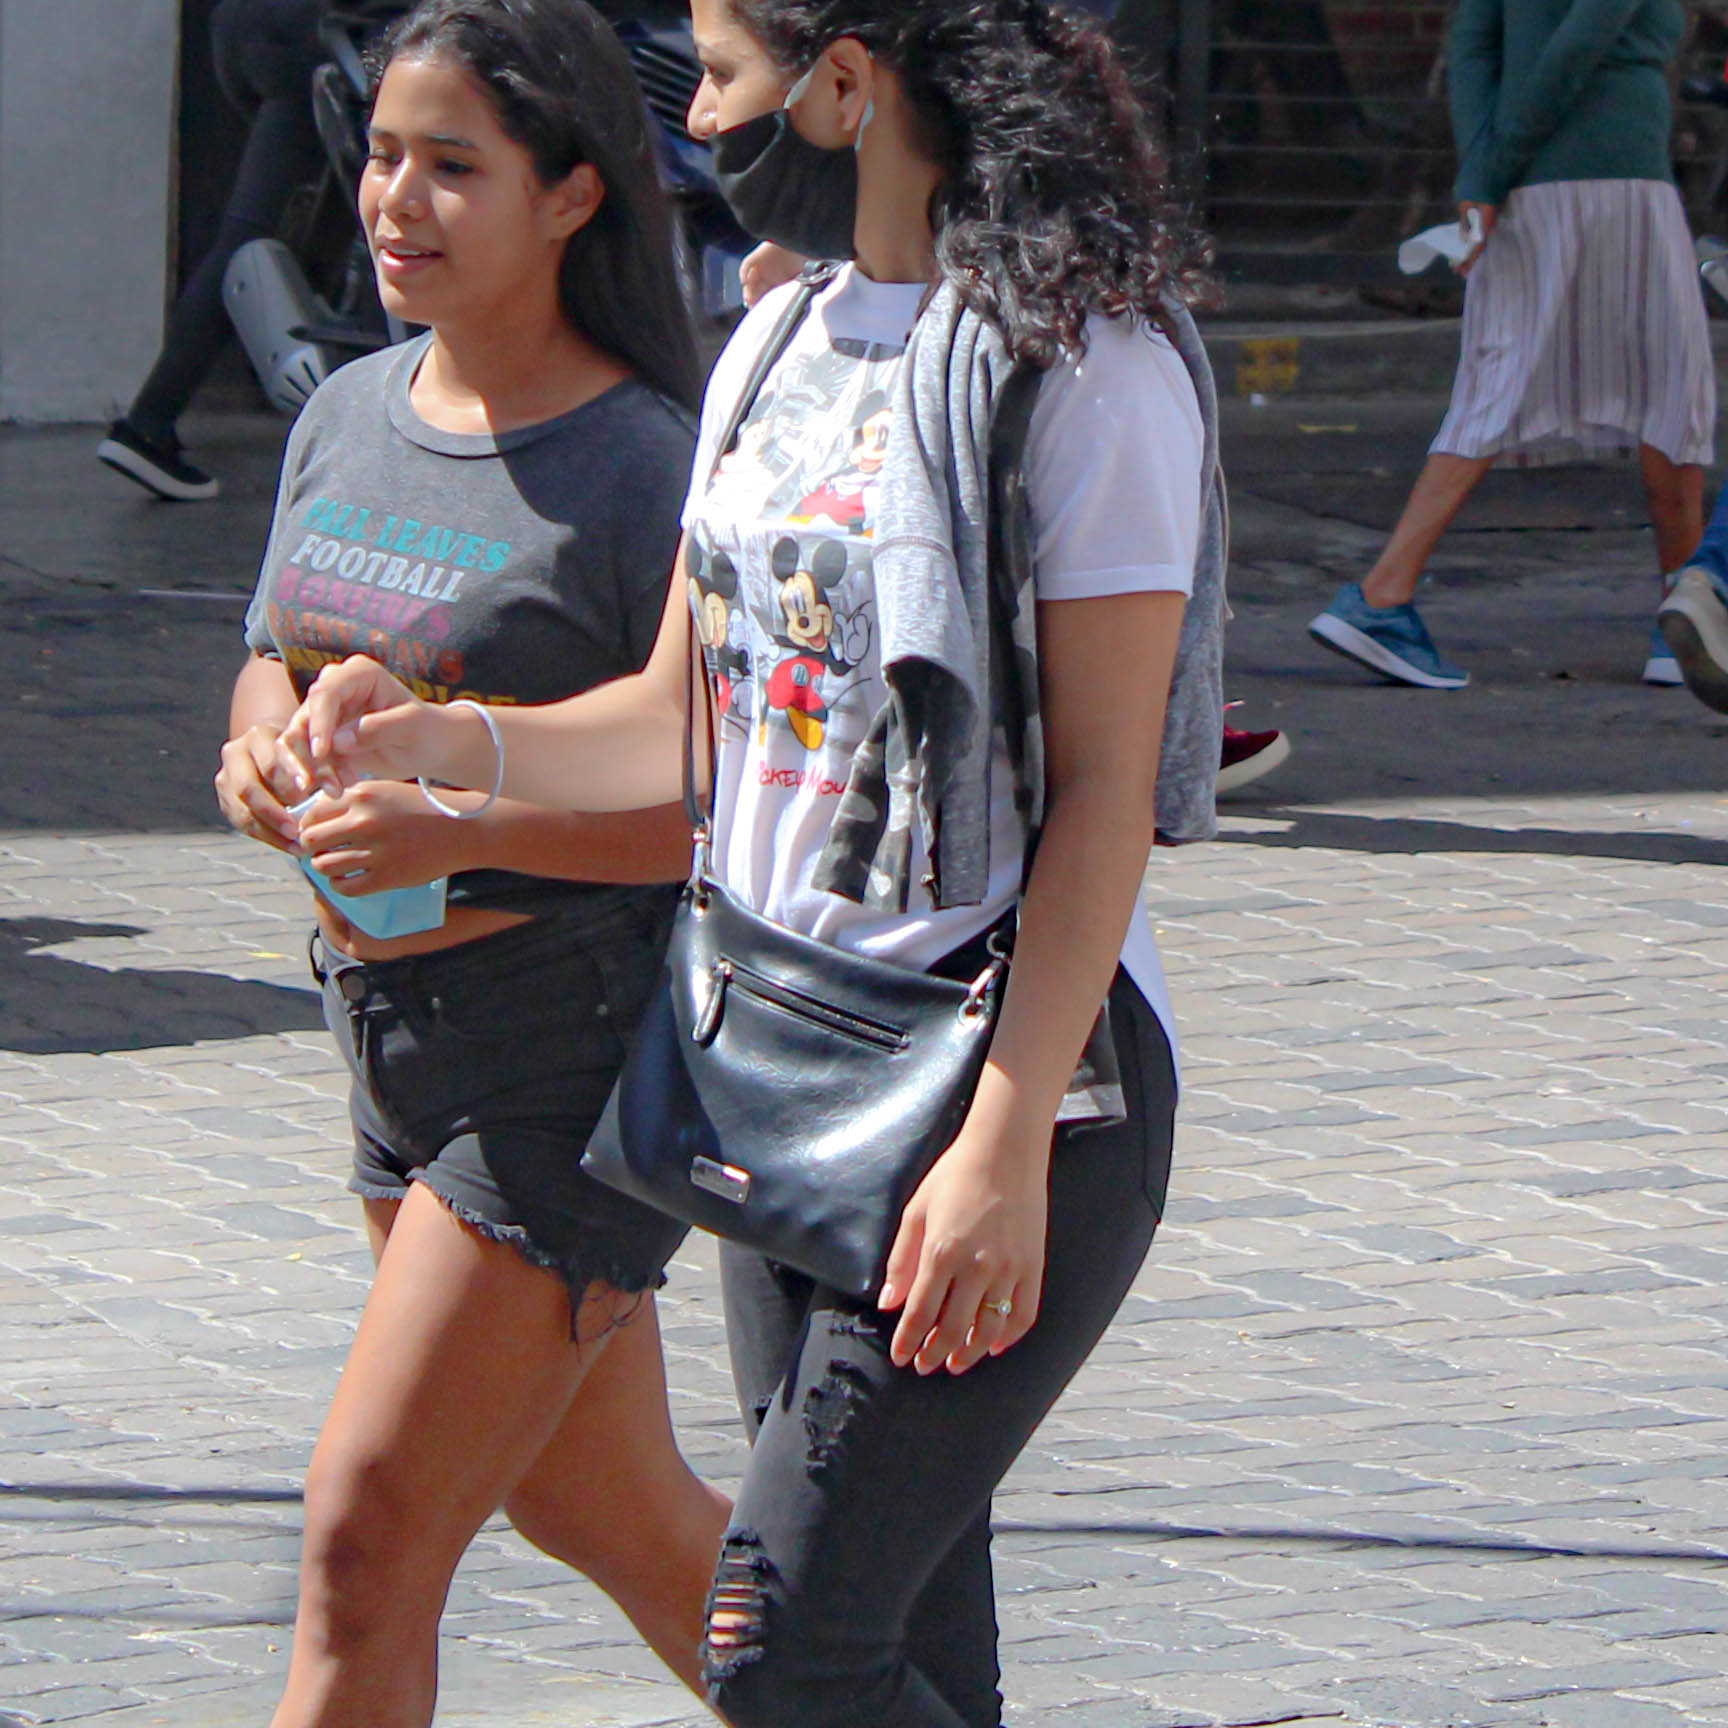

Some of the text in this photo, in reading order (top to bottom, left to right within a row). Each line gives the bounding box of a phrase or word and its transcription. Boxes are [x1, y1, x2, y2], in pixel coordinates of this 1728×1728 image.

[290, 534, 465, 603] FOOTBALL
[301, 496, 513, 572] FALL LEAVES
